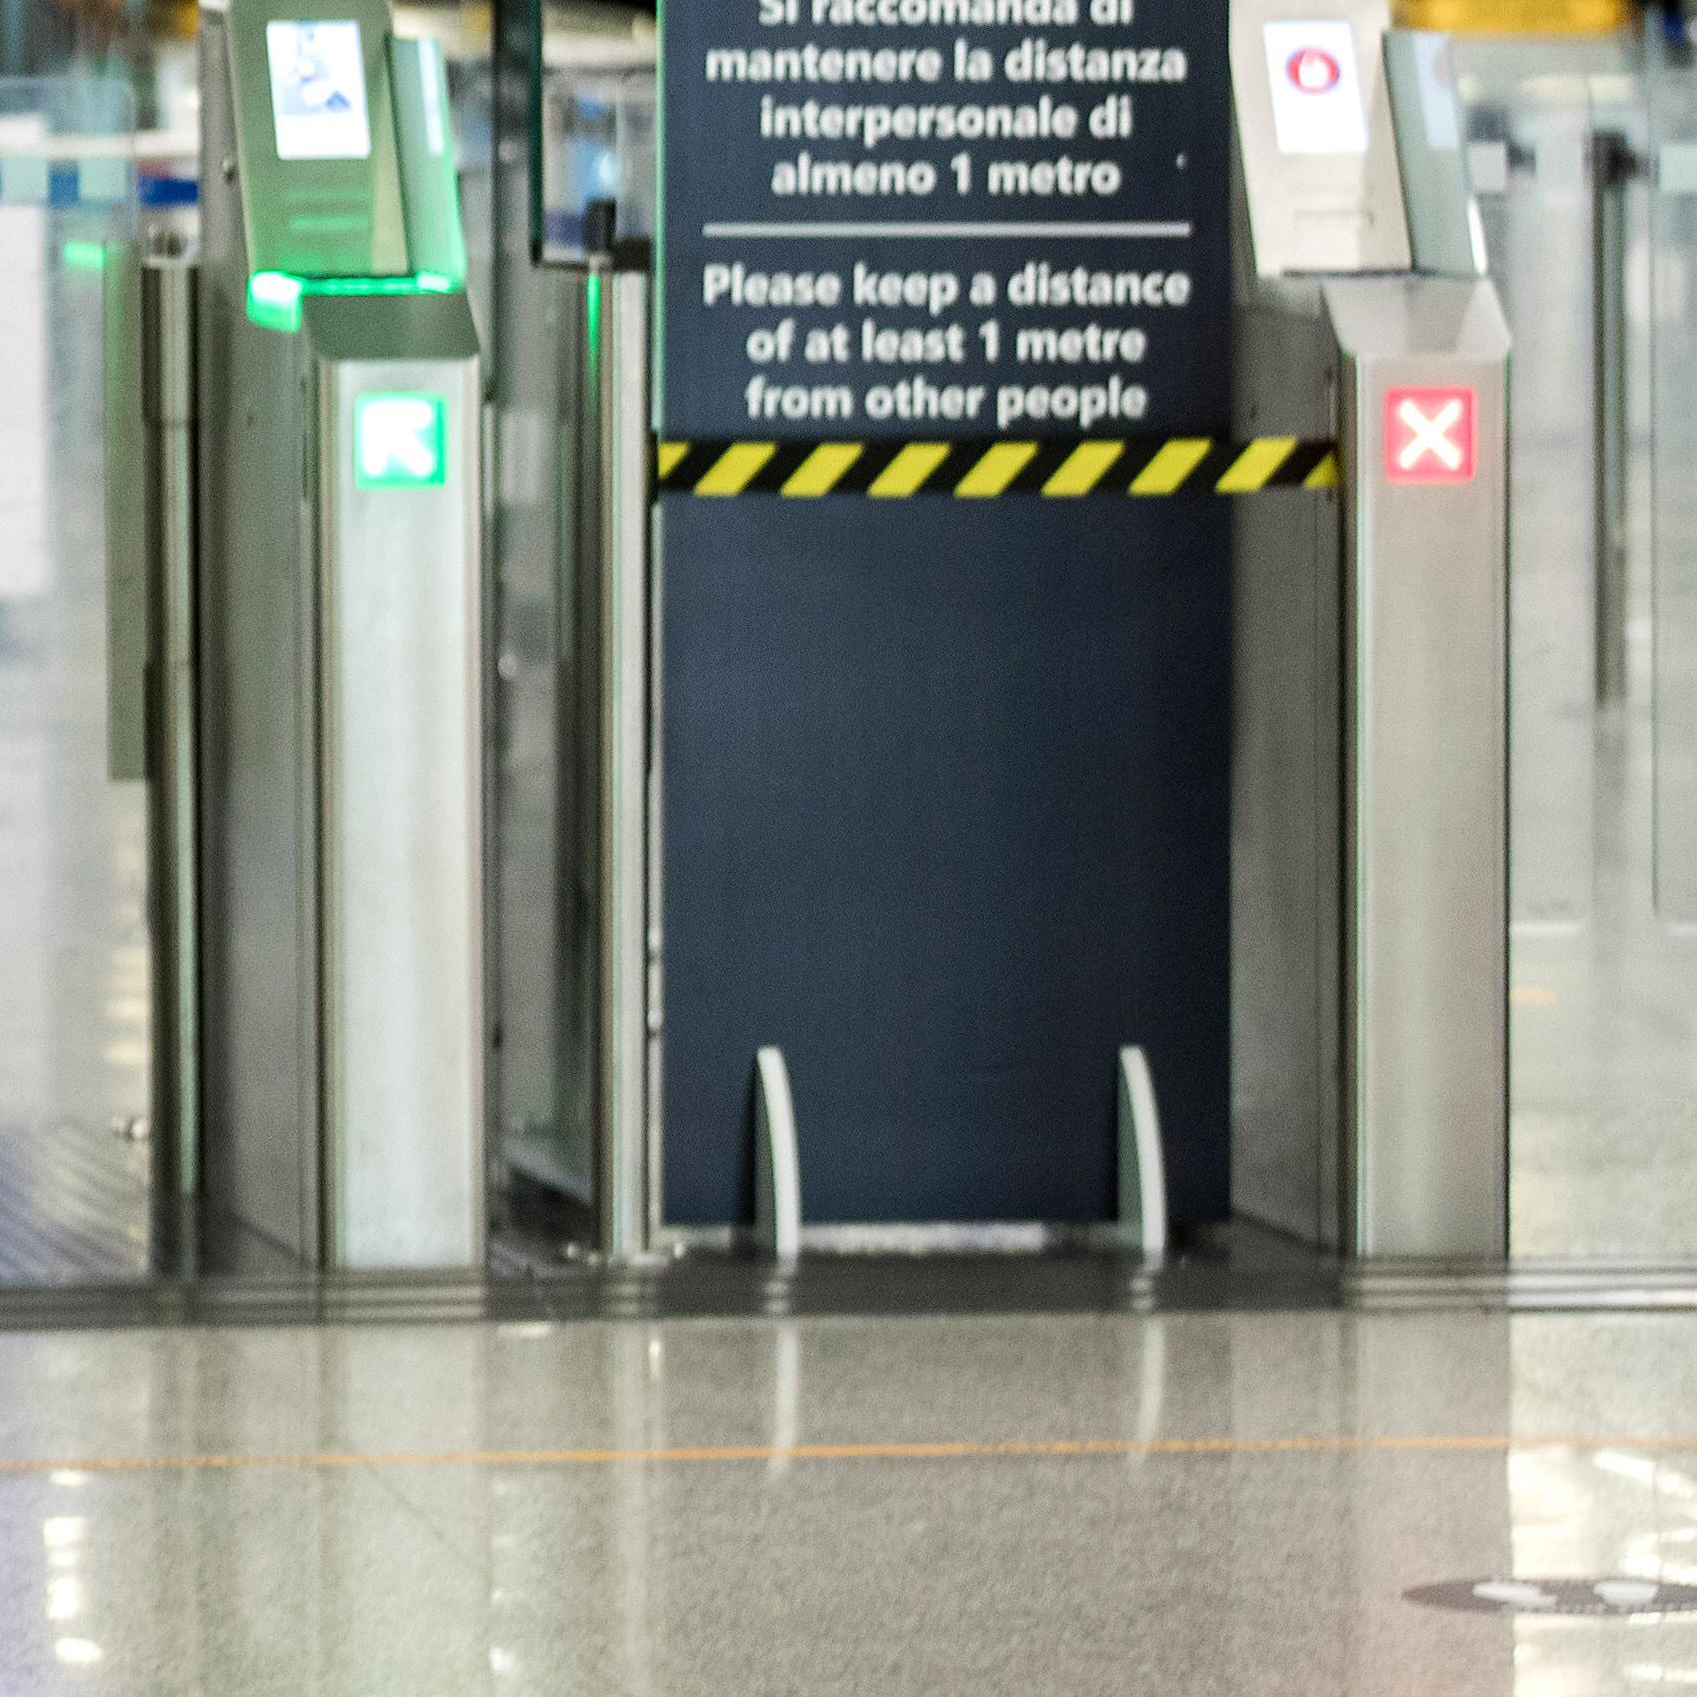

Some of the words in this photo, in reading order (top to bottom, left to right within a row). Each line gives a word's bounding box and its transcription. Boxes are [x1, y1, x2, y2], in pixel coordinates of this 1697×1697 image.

[706, 44, 942, 81] mantenere
[955, 38, 993, 81] la
[1004, 38, 1187, 81] distanza
[761, 95, 1078, 148] interpersonale
[1089, 95, 1132, 138] di
[772, 151, 936, 194] almeno
[951, 152, 970, 193] 1
[988, 156, 1121, 194] metro
[704, 262, 841, 305] Please
[854, 263, 959, 315] keep
[970, 273, 996, 305] a
[1008, 262, 1190, 305] distance
[747, 318, 794, 362] of
[805, 324, 848, 362] at
[862, 318, 964, 362] least
[980, 321, 998, 361] 1
[1017, 323, 1146, 361] metre
[746, 374, 853, 418] from
[865, 375, 985, 419] other
[997, 376, 1147, 429] people
